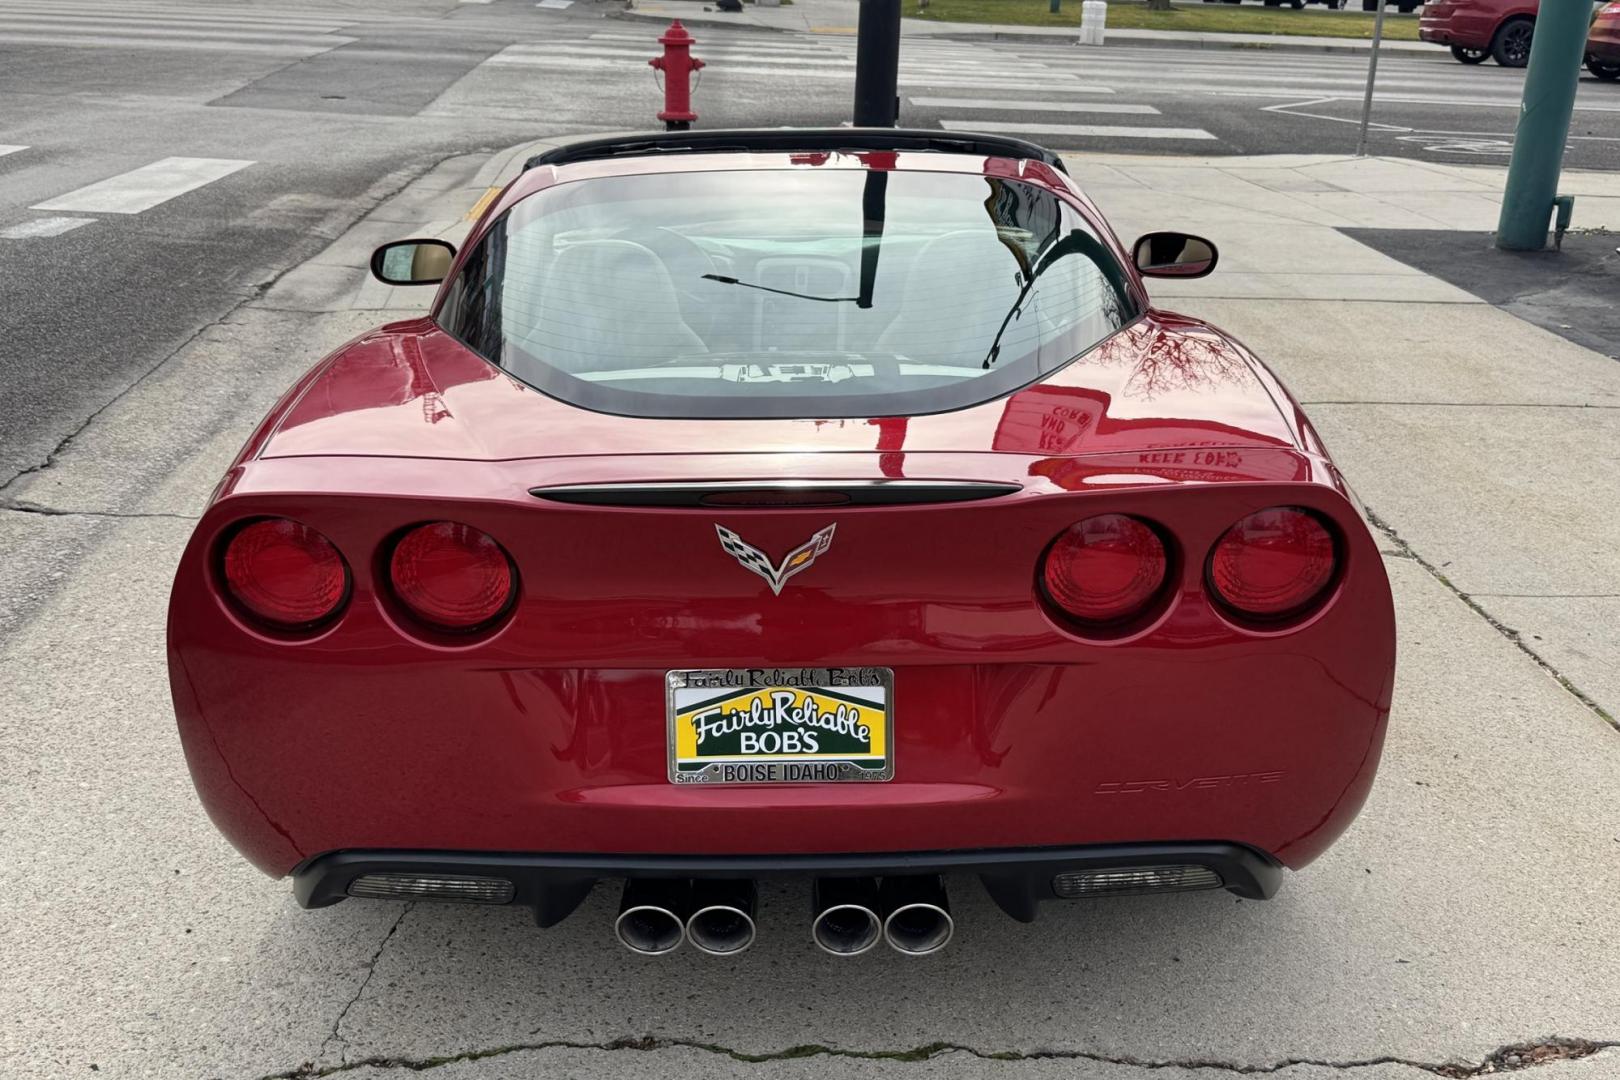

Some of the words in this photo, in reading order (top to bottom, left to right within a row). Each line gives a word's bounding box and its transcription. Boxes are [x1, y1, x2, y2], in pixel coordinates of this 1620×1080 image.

[740, 727, 819, 754] BOB'S
[676, 773, 708, 783] Since
[724, 764, 777, 782] BOISE
[783, 763, 838, 781] IDAHO
